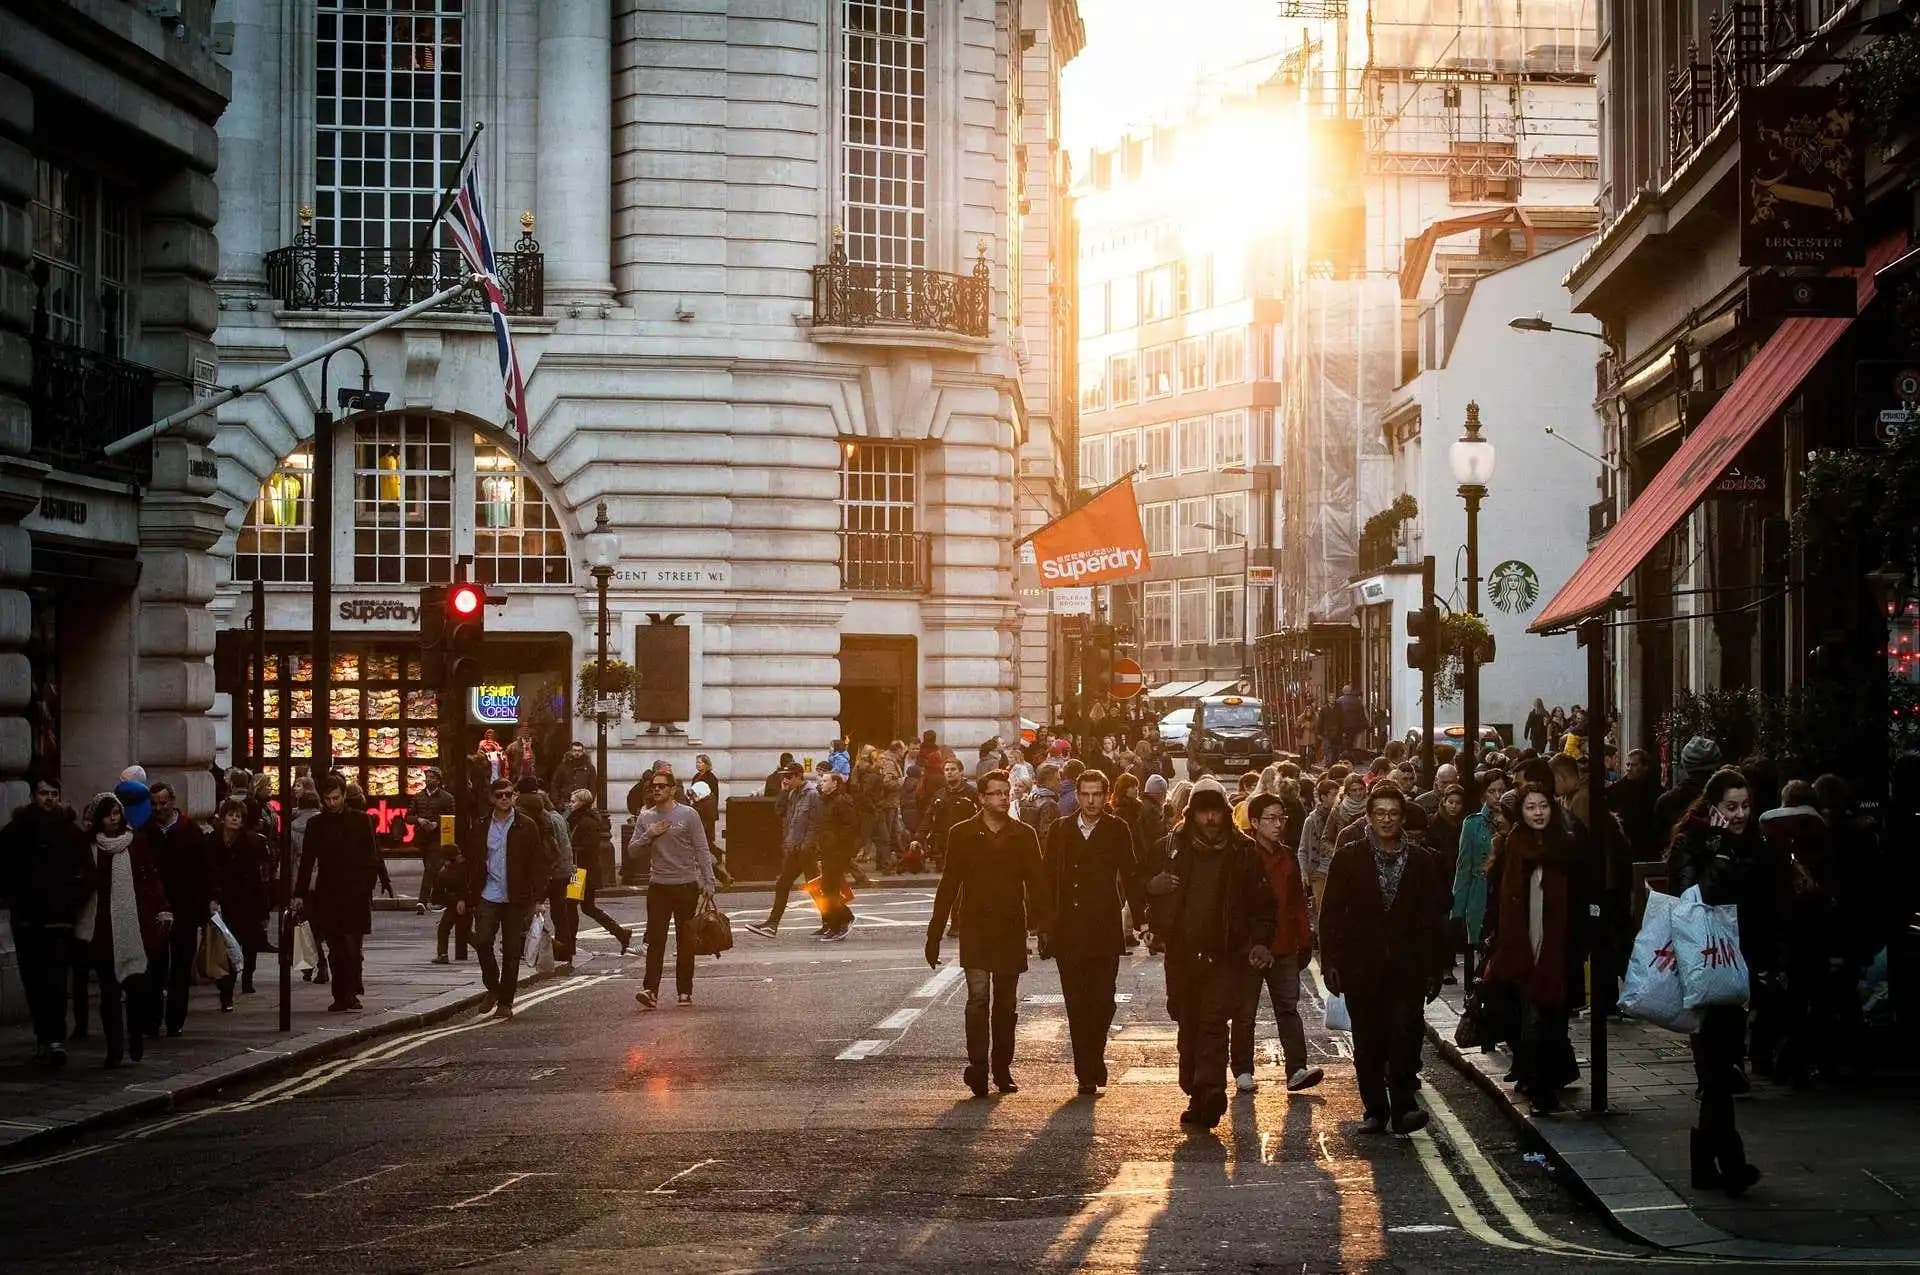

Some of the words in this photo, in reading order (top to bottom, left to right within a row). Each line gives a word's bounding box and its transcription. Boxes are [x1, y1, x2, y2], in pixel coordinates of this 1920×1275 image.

[1765, 236, 1843, 248] LEICESTER
[1785, 251, 1824, 261] ARMS
[1042, 546, 1142, 580] Superdry
[616, 571, 648, 581] GENT
[657, 571, 701, 581] STREET
[340, 601, 420, 624] Superdry
